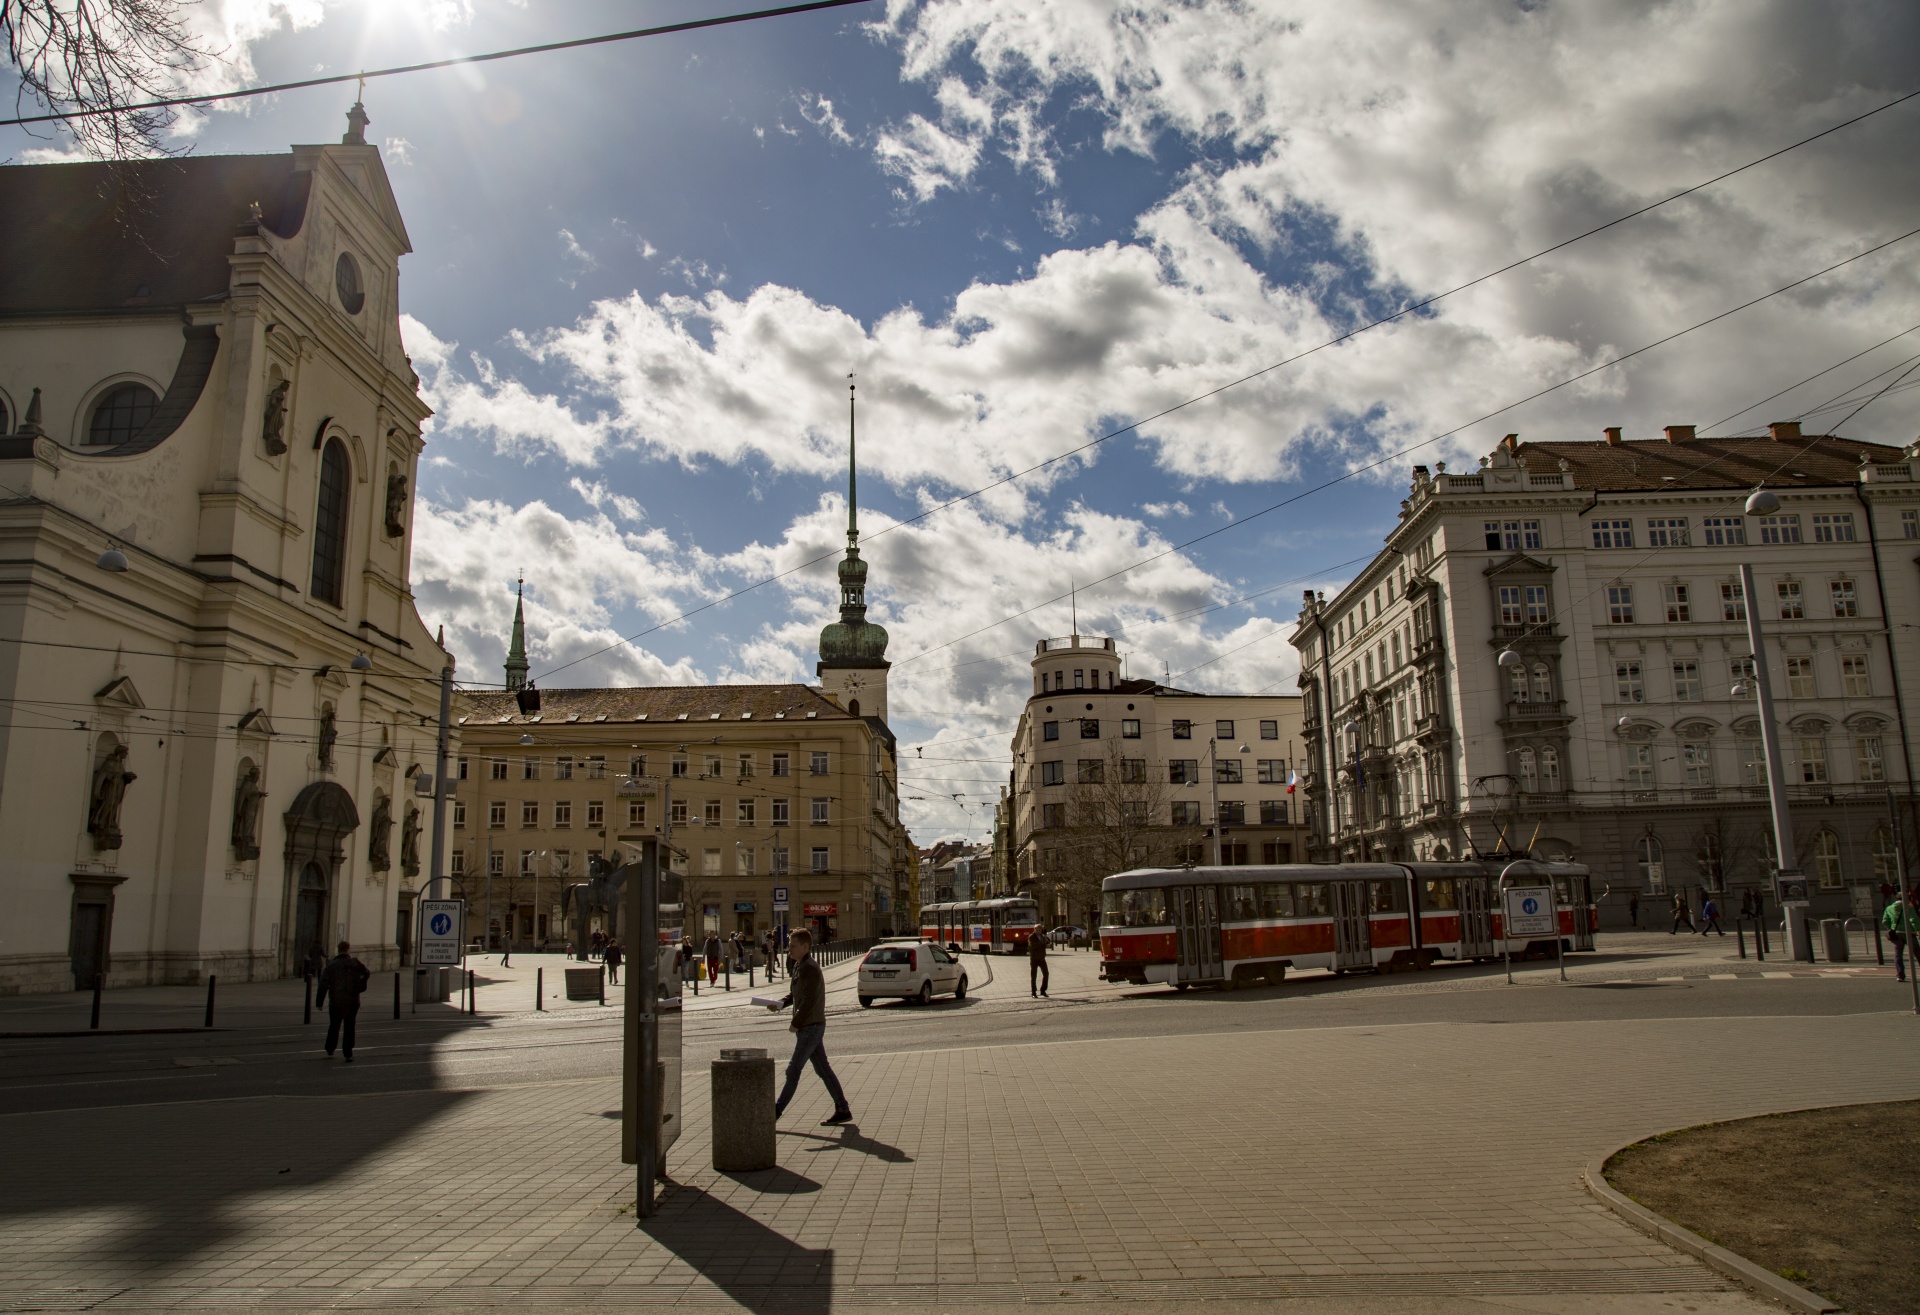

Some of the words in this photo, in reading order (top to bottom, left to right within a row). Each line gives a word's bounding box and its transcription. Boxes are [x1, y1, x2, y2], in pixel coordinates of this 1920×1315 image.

[426, 903, 440, 911] PĚŠÍ
[441, 903, 457, 911] ZÓNA
[810, 904, 831, 912] okay
